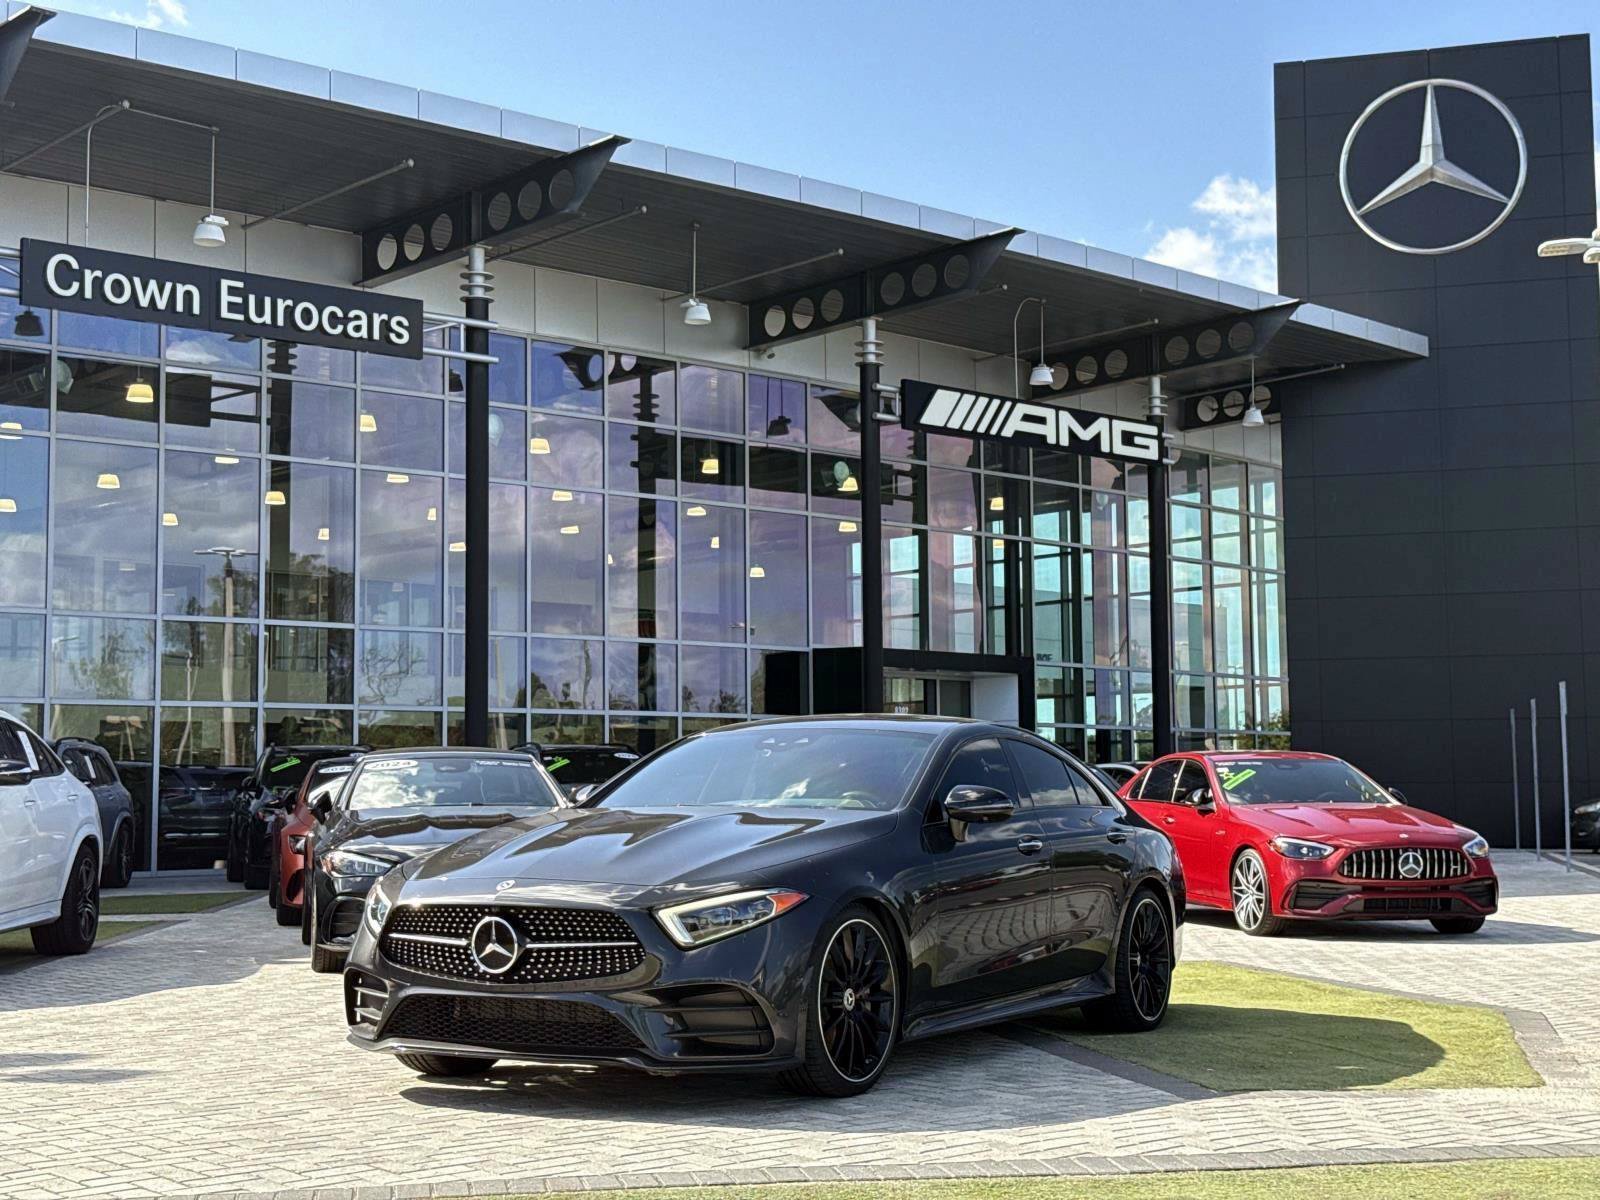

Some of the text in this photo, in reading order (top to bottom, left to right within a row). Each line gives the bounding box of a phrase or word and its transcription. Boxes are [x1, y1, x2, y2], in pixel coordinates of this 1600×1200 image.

[45, 253, 411, 346] Crown Eurocars
[1000, 401, 1159, 461] AMG
